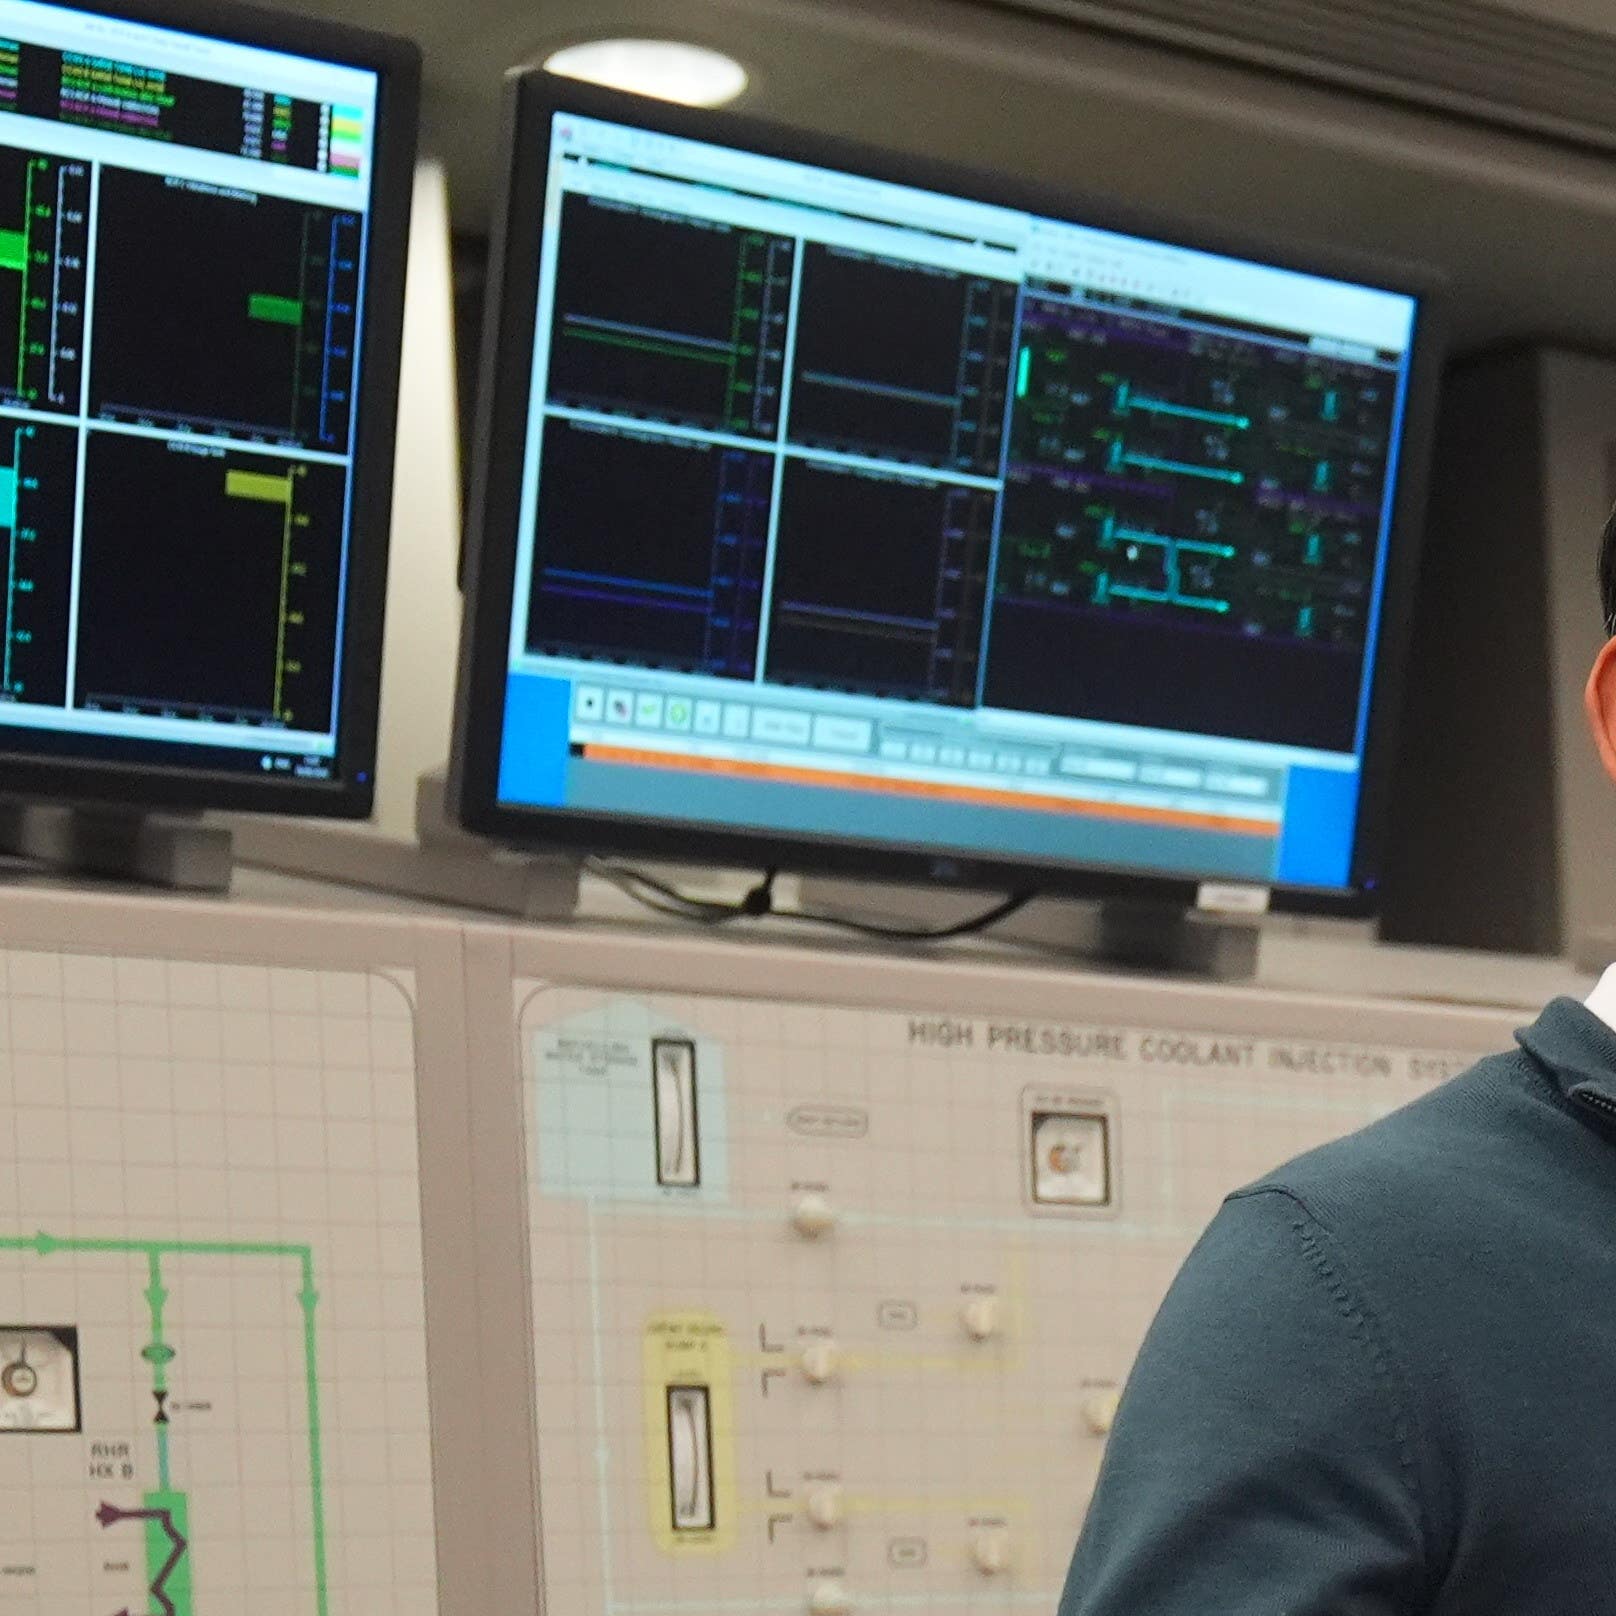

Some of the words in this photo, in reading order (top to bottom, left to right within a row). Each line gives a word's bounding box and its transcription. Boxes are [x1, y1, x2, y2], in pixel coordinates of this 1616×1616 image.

[908, 1021, 972, 1048] HIGH
[987, 1026, 1127, 1060] PRESSURE
[1139, 1037, 1255, 1067] COOLANT
[1268, 1047, 1391, 1078] INJECTION
[91, 1443, 129, 1458] RHR
